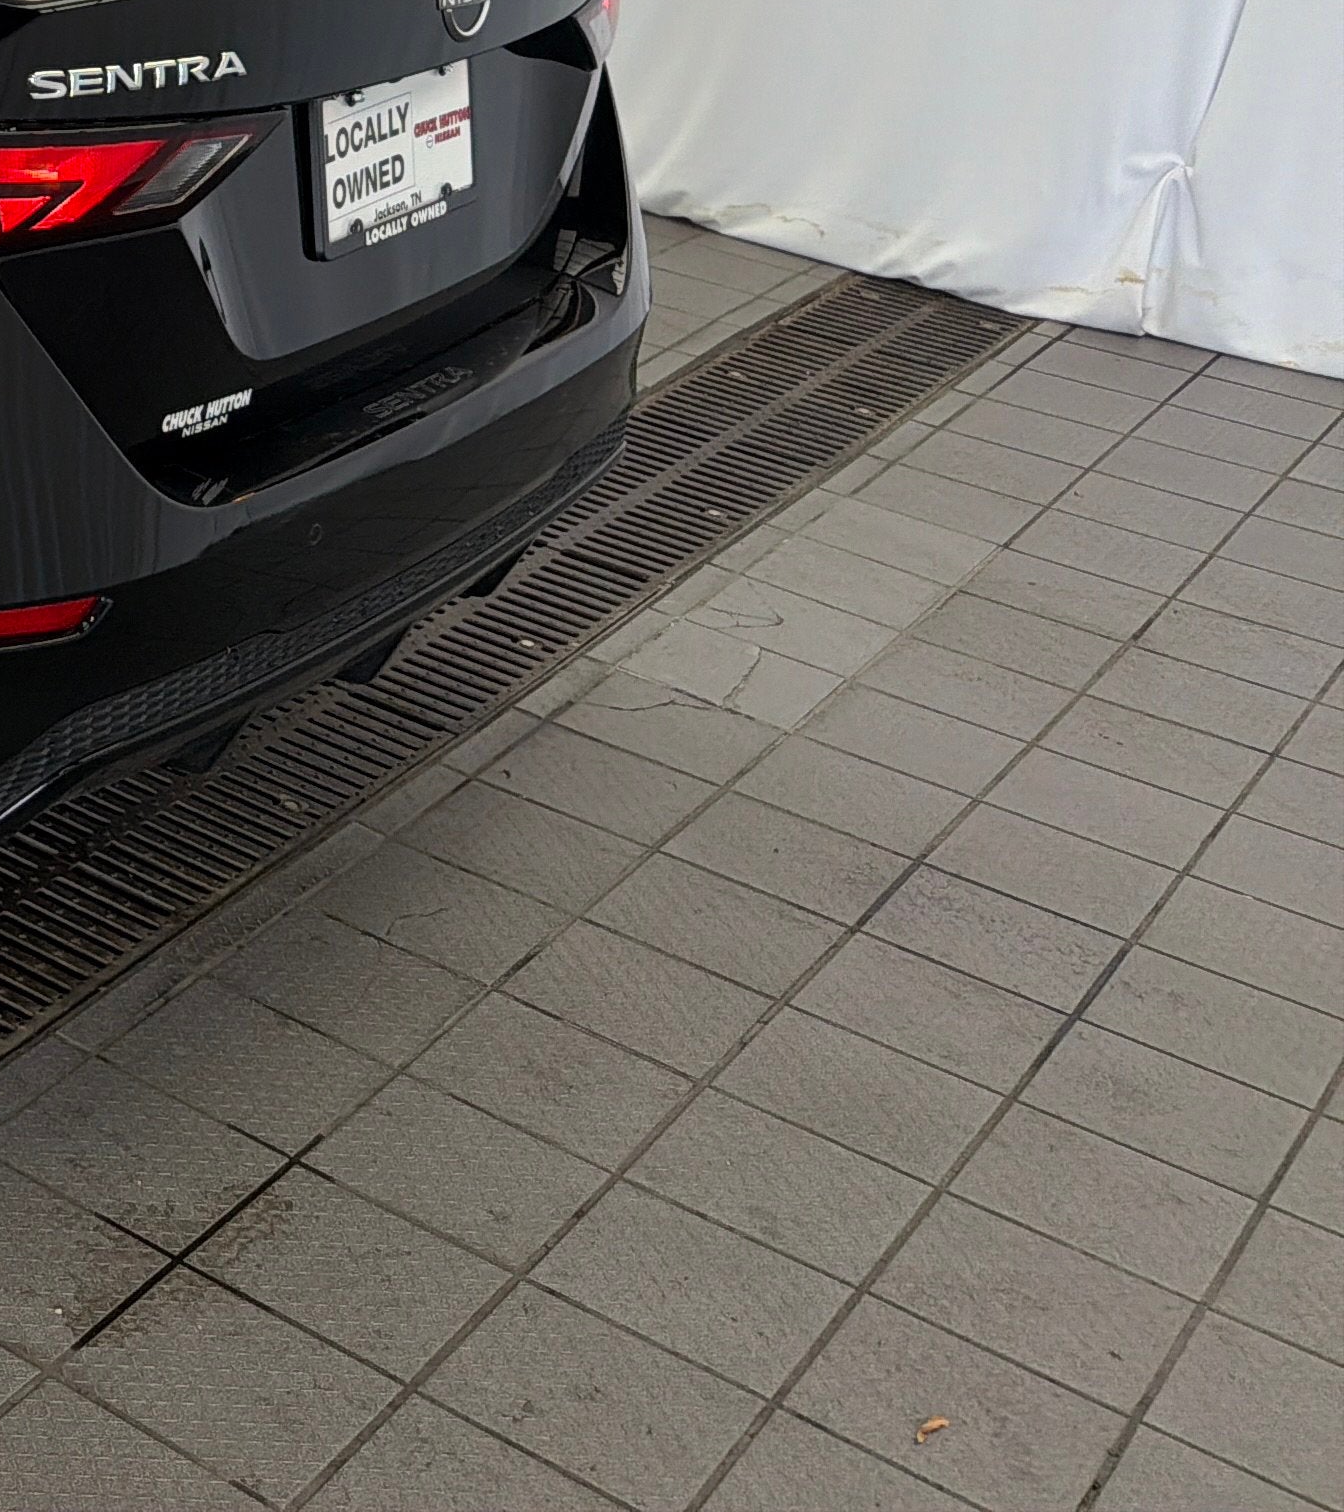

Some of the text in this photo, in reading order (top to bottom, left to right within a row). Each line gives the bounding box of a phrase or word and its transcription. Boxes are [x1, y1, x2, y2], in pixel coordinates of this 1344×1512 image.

[28, 51, 247, 99] SENTRA
[324, 102, 409, 164] LOCALLY
[332, 154, 405, 209] OWNED
[365, 200, 447, 246] LOCALLY OWNED
[374, 190, 422, 222] Jackson, TN
[162, 388, 253, 433] CHUCK HUTTON
[181, 414, 229, 438] NISSAN
